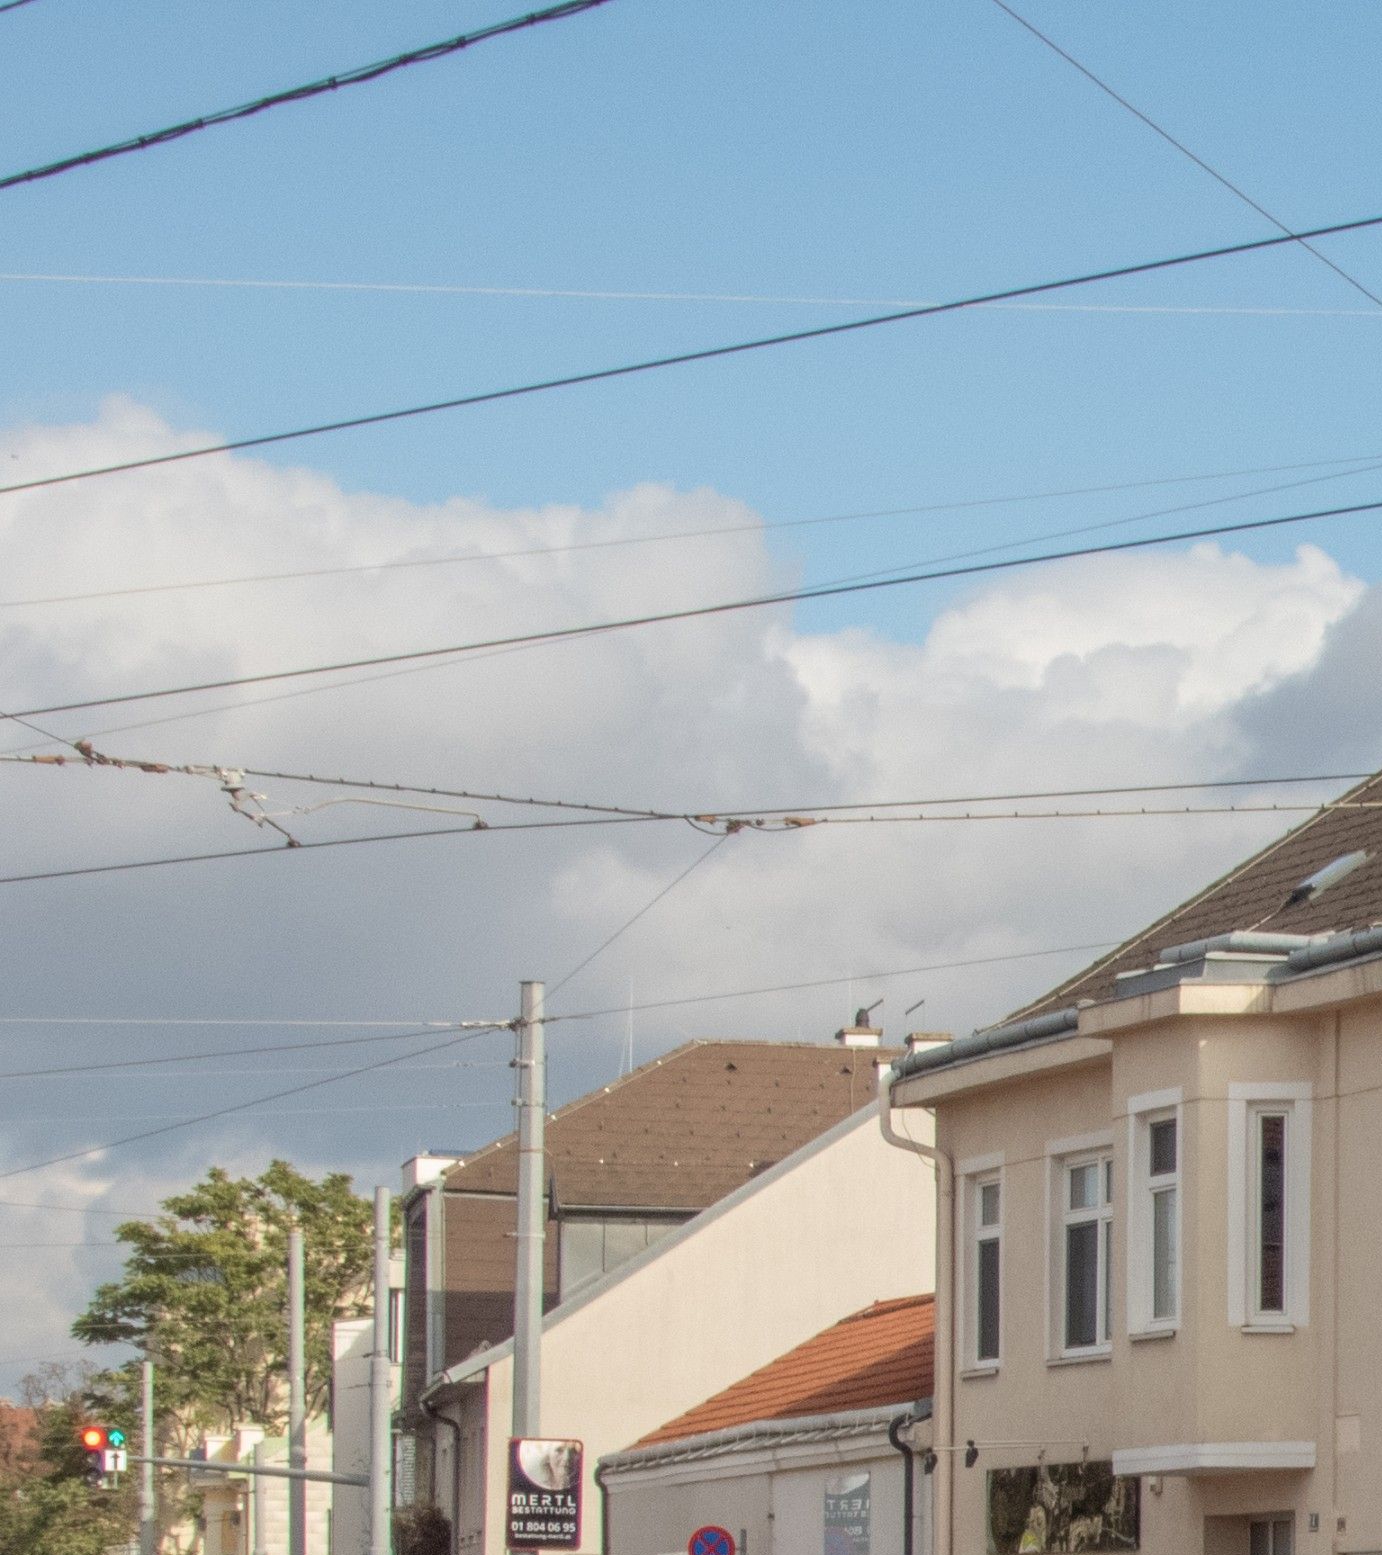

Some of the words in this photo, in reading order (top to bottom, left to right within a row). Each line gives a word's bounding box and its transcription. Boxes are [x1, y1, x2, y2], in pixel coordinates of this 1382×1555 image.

[512, 1494, 576, 1506] MERTL
[512, 1506, 576, 1515] BESTATTUNG
[512, 1522, 523, 1531] 01
[526, 1522, 545, 1532] 804
[548, 1522, 560, 1532] 06
[563, 1523, 576, 1533] 95
